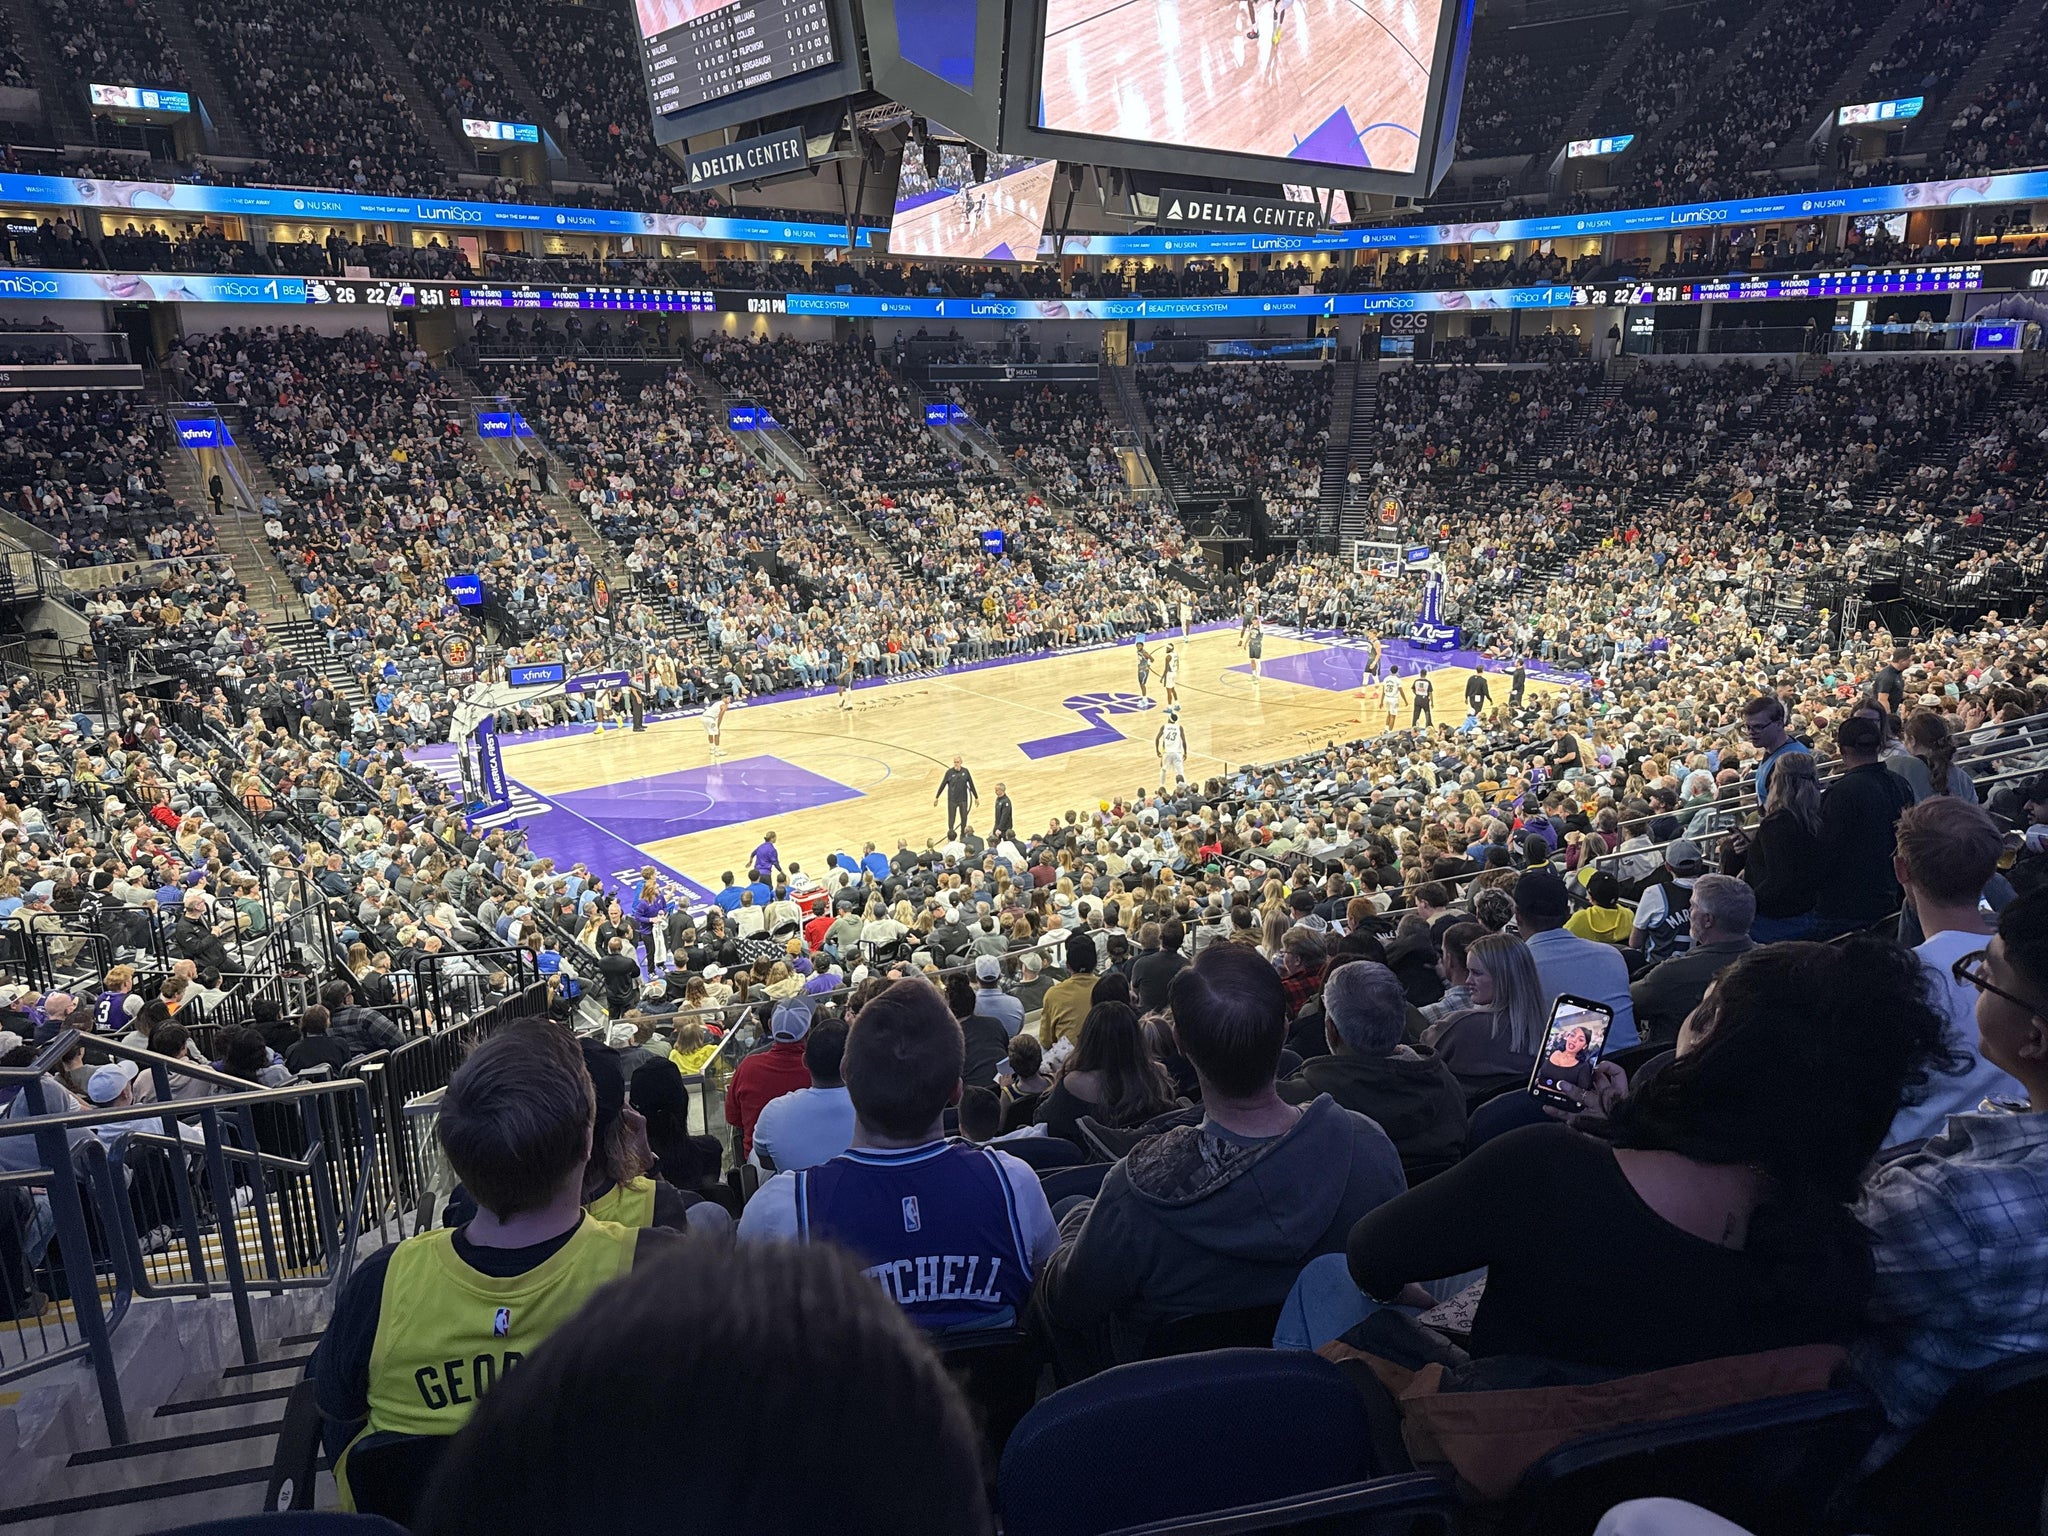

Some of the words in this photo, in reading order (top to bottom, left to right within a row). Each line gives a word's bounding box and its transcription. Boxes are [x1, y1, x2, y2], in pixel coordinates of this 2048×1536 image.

[734, 10, 755, 24] WILLIAMS
[737, 26, 755, 40] COLLIER
[651, 44, 668, 56] WALKER
[739, 40, 764, 56] FILIPOWSKI
[657, 72, 675, 84] JACKSON
[702, 153, 744, 180] DELTA
[748, 139, 800, 168] CENTER
[307, 201, 320, 210] NU
[1813, 201, 1826, 209] NU
[418, 205, 481, 223] LumiSpa
[1188, 202, 1246, 222] DELTA
[1253, 206, 1315, 227] CENTER
[1670, 208, 1728, 224] LumiSpa
[1252, 238, 1301, 249] LumiSpa
[1949, 272, 1961, 280] 149
[0, 277, 58, 295] miSpa
[210, 282, 259, 297] miSpa
[336, 288, 356, 303] 26
[366, 288, 385, 304] 22
[420, 289, 443, 305] 3:51
[1509, 293, 1539, 304] miSpa
[1592, 291, 1606, 304] 26
[1614, 290, 1629, 303] 22
[1657, 287, 1677, 302] 3:51
[748, 299, 771, 313] 07:31
[773, 300, 786, 313] PM
[801, 300, 824, 309] DEVICE
[825, 301, 849, 309] SYSTEM
[971, 304, 1016, 315] LumiSpa
[1149, 305, 1174, 313] BEAUTY
[1202, 303, 1228, 311] SYSTEM
[1364, 297, 1413, 309] LumiSpa
[1390, 313, 1428, 329] G2G
[484, 421, 507, 430] xfinity
[182, 429, 212, 439] xfinity
[1382, 509, 1396, 522] 24
[451, 586, 477, 595] xfinity
[523, 670, 552, 681] xfinity
[1165, 732, 1177, 741] 43
[486, 733, 495, 757] FIRST
[491, 757, 504, 795] AMERICA
[1666, 909, 1690, 929] MAR
[98, 1000, 111, 1023] 3
[868, 1255, 1001, 1304] TCHELL
